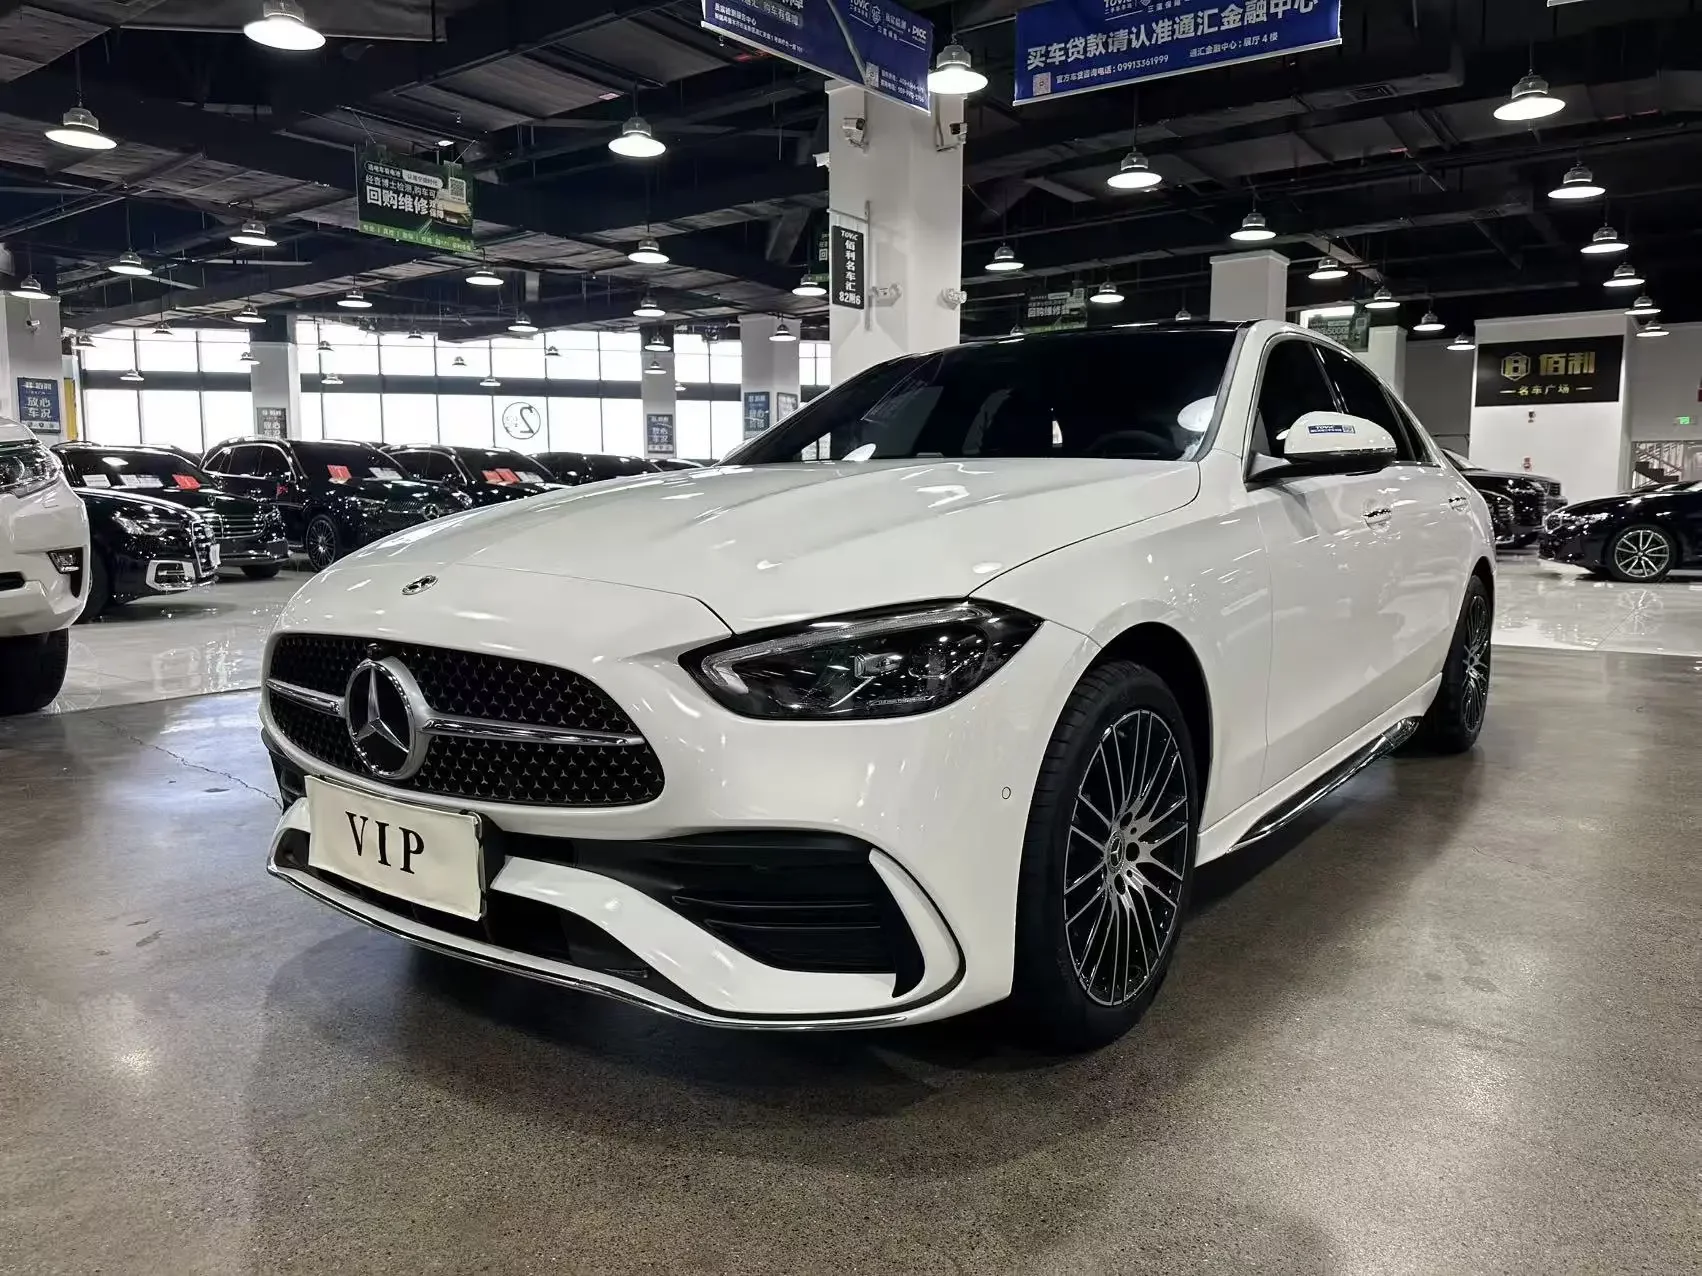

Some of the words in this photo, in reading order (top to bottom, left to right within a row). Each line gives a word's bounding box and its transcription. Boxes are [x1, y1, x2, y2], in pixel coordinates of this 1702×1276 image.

[1026, 0, 1319, 70] 买车贷款请认准通汇金融中心
[366, 185, 429, 216] 回购维修
[1539, 351, 1596, 376] 佰利
[27, 396, 51, 408] 放心
[1518, 384, 1570, 396] 名车广场
[28, 407, 52, 418] 车况
[345, 810, 425, 875] VIP
